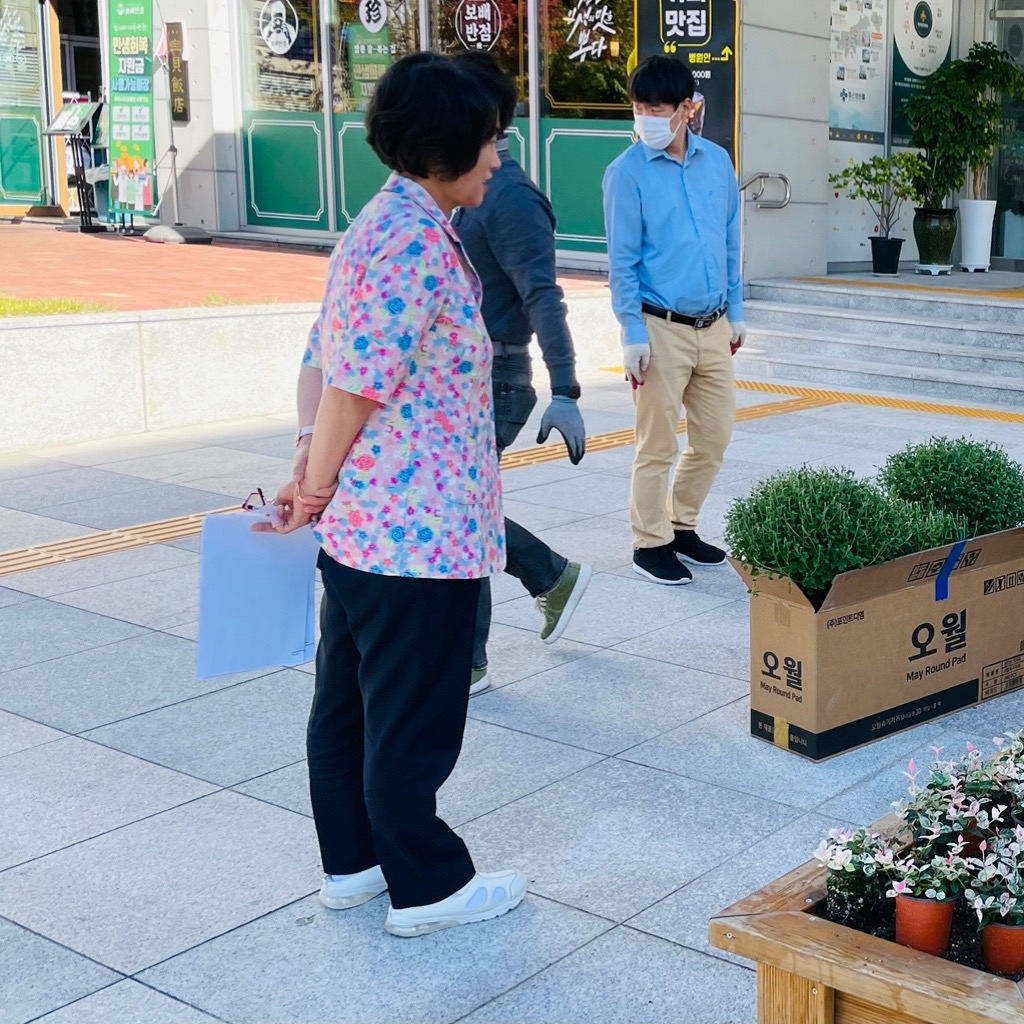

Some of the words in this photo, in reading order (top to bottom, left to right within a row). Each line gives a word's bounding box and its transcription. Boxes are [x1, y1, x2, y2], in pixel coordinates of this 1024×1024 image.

[464, 3, 492, 22] 보배
[665, 9, 707, 37] 맛집
[464, 22, 492, 42] 반점
[112, 36, 149, 55] 민생회복
[118, 57, 145, 74] 지원금
[691, 70, 711, 79] 000원
[907, 608, 967, 663] 오월
[761, 651, 803, 692] 오월
[906, 669, 925, 683] May
[925, 658, 951, 677] Round
[951, 653, 967, 667] Pad
[760, 681, 773, 693] May
[772, 685, 792, 700] Round
[791, 692, 803, 704] Pad
